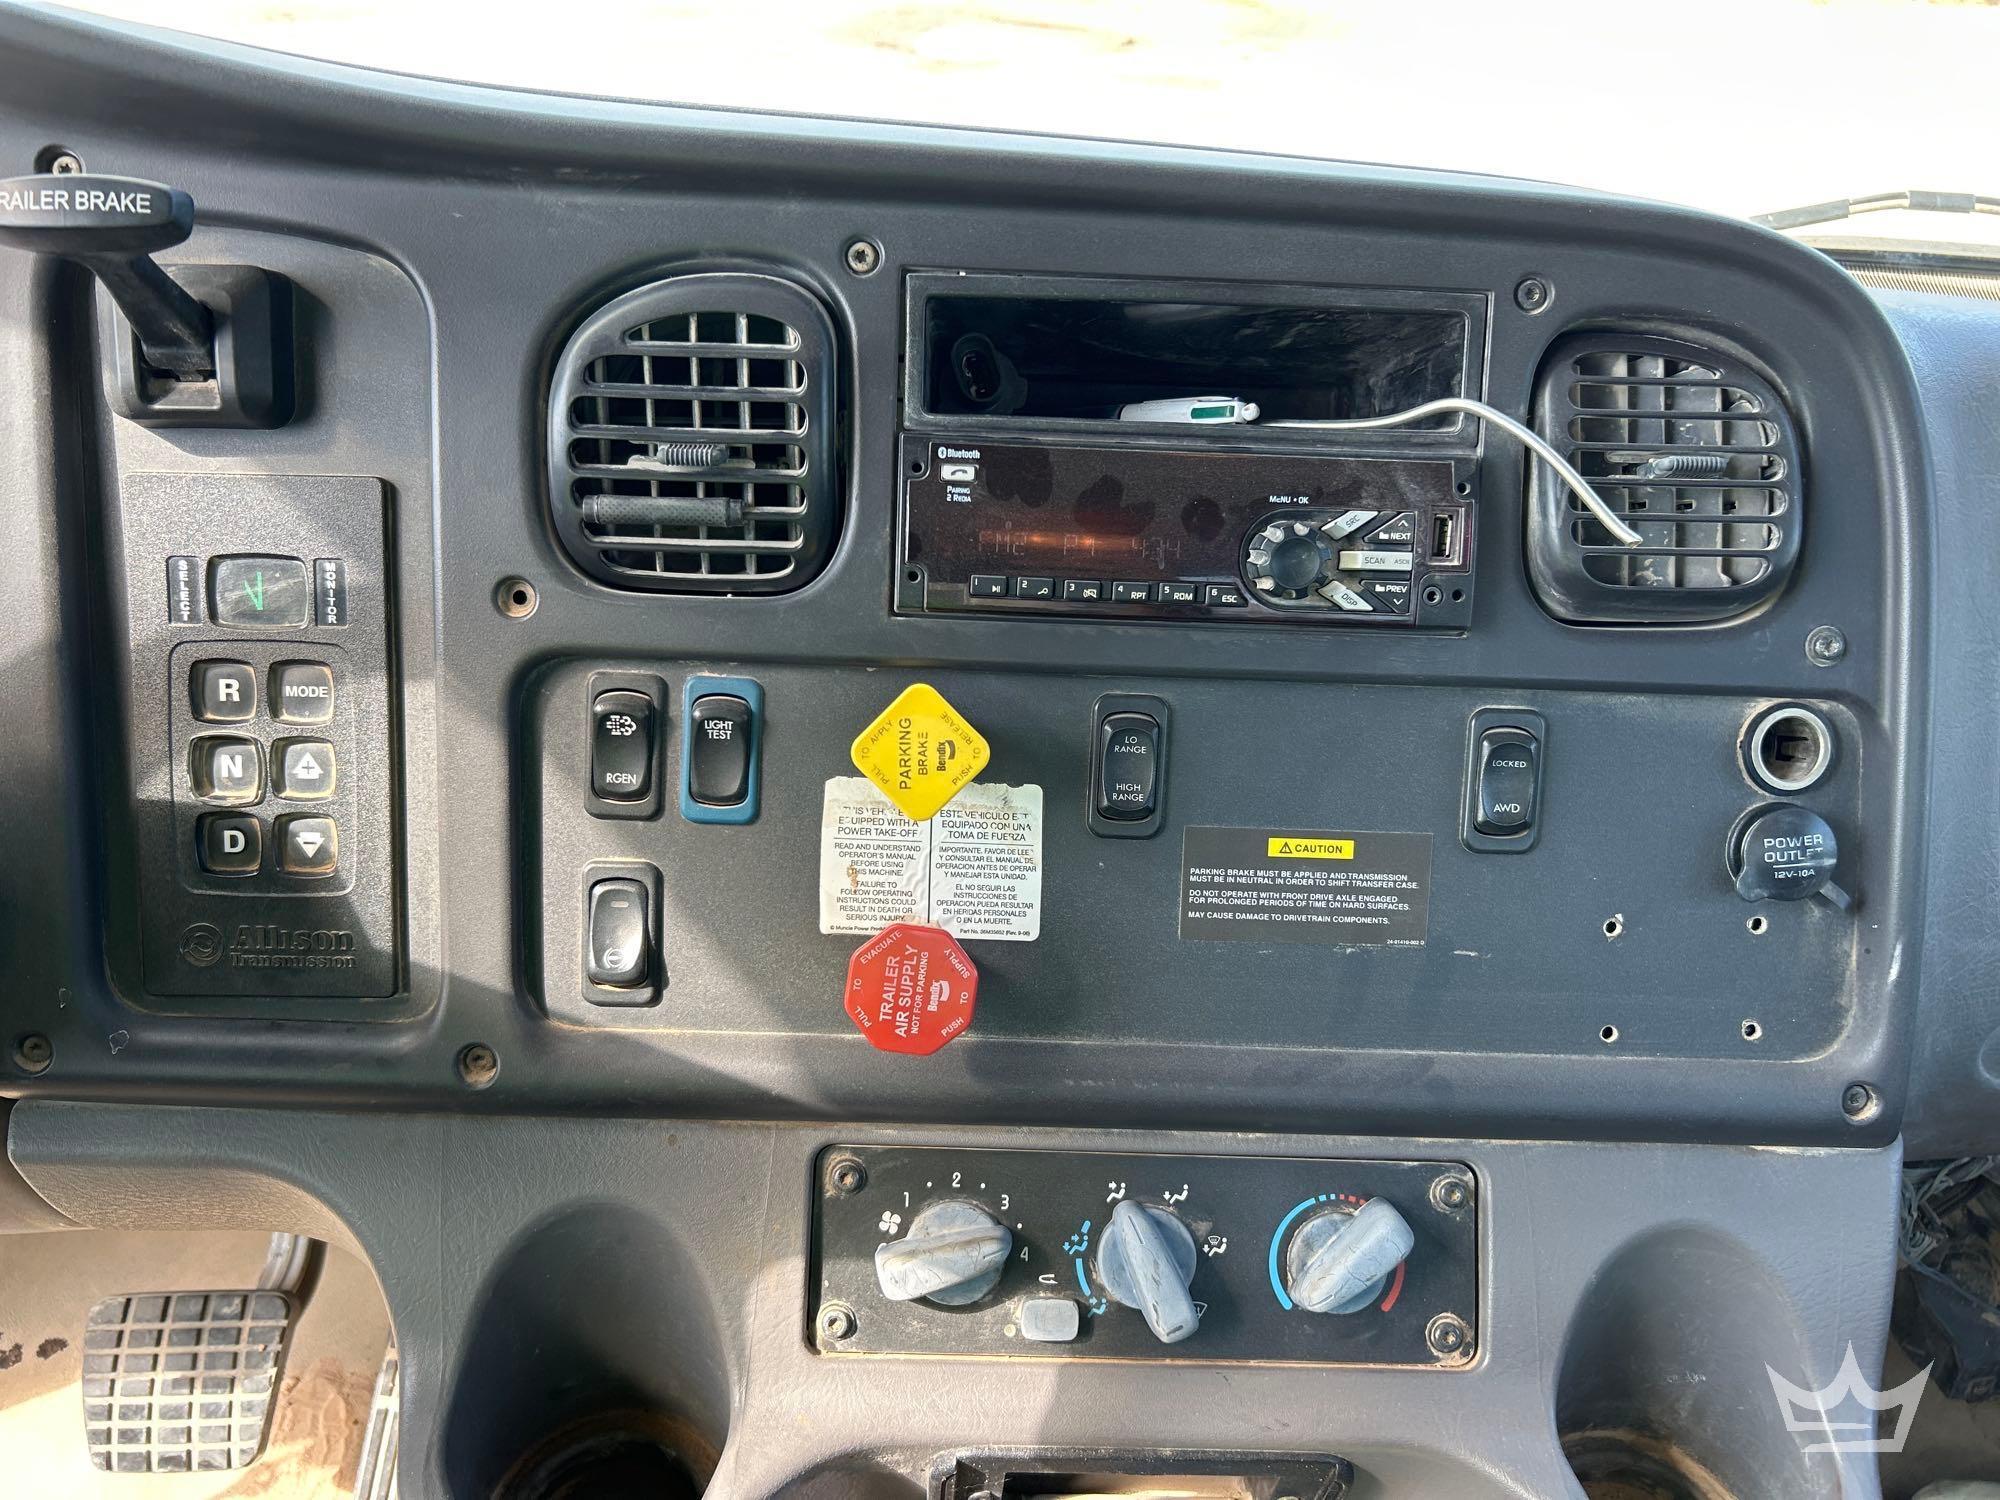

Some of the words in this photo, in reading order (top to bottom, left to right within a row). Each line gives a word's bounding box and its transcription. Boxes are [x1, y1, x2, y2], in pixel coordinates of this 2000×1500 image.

[75, 191, 151, 213] BRAKE
[948, 449, 980, 459] Bluetooth
[1299, 496, 1308, 504] OK
[1346, 515, 1360, 528] SRC
[178, 560, 190, 621] SELECT
[1021, 580, 1027, 588] 2
[1069, 583, 1075, 591] 3
[1164, 586, 1170, 594] 5
[1386, 585, 1407, 593] PREV
[326, 562, 337, 623] MONITOR
[1130, 591, 1146, 600] RPT
[1174, 592, 1193, 601] RDM
[1211, 588, 1218, 596] 6
[1222, 594, 1237, 603] ESC
[1341, 593, 1358, 607] DISP
[219, 679, 240, 702] R
[285, 685, 328, 698] MODE
[704, 720, 733, 731] LIGHT
[871, 719, 893, 744] APPLY
[941, 711, 972, 745] RELEASE
[707, 730, 732, 740] TEST
[862, 746, 870, 758] TO
[899, 718, 912, 789] PARKING
[918, 732, 928, 775] BRAKE
[973, 748, 980, 759] TO
[1114, 745, 1147, 754] RANGE
[937, 742, 946, 771] Bendix
[221, 755, 242, 778] N
[1492, 760, 1526, 768] LOCKED
[606, 773, 636, 785] RGEN
[871, 763, 889, 785] PULL
[952, 765, 973, 786] PUSH
[1116, 783, 1141, 791] HIGH
[1113, 793, 1144, 801] RANGE
[1493, 803, 1520, 813] AWD
[838, 827, 871, 835] POWER
[874, 828, 918, 837] TAKE-OFF
[942, 820, 988, 829] EQUIPADO
[990, 822, 1010, 830] CON
[1012, 823, 1032, 831] UNA
[224, 830, 245, 853] D
[948, 831, 974, 839] TOMA
[991, 832, 1026, 841] FUERZA
[1764, 834, 1822, 848] POWER
[873, 844, 921, 852] UNDERSTAND
[1294, 844, 1343, 854] CAUTION
[1349, 873, 1407, 881] TRANSMISSION
[1774, 869, 1815, 879] 12V-10A
[872, 889, 913, 897] OPERATING
[983, 909, 1027, 917] PERSONALES
[1284, 914, 1330, 922] DRIVETRAIN
[1333, 916, 1389, 924] COMPONENTS.
[230, 925, 356, 950] Allison
[860, 931, 902, 964] EVACUATE
[230, 952, 357, 968] Transmission
[944, 948, 970, 979] SUPPLY
[899, 944, 918, 1007] SUPPLY
[917, 952, 928, 993] PARKING
[853, 979, 861, 990] TO
[879, 956, 900, 1022] TRAILER
[927, 980, 941, 1012] Bendix
[960, 992, 968, 1004] TO
[914, 996, 922, 1013] FOR
[855, 1006, 872, 1028] PULL
[895, 1011, 909, 1038] AIR
[911, 1016, 920, 1034] NOT
[941, 1017, 964, 1037] PUSH
[952, 1172, 961, 1187] 2
[903, 1192, 909, 1207] 1
[1001, 1194, 1009, 1209] 3
[1020, 1246, 1029, 1262] 4
